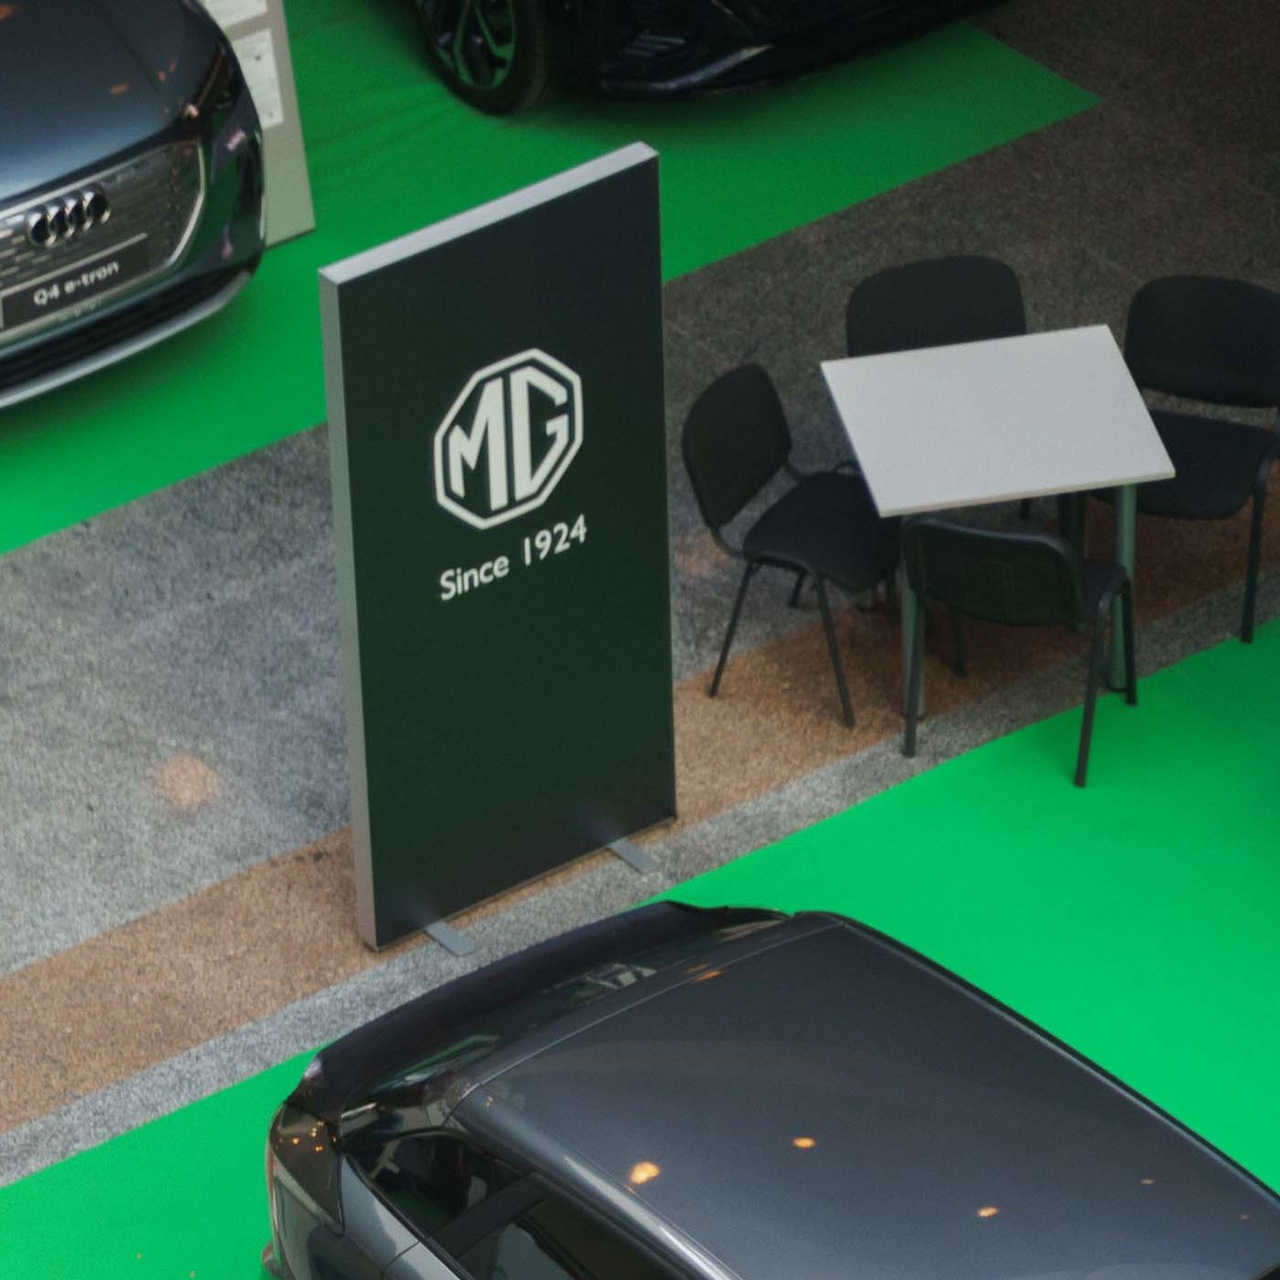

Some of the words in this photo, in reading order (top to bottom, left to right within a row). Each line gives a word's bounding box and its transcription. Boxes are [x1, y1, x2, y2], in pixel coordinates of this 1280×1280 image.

[33, 283, 61, 306] Q4
[63, 261, 120, 294] e-tron
[447, 365, 569, 512] MG
[439, 555, 511, 601] Since
[523, 513, 588, 567] 1924
